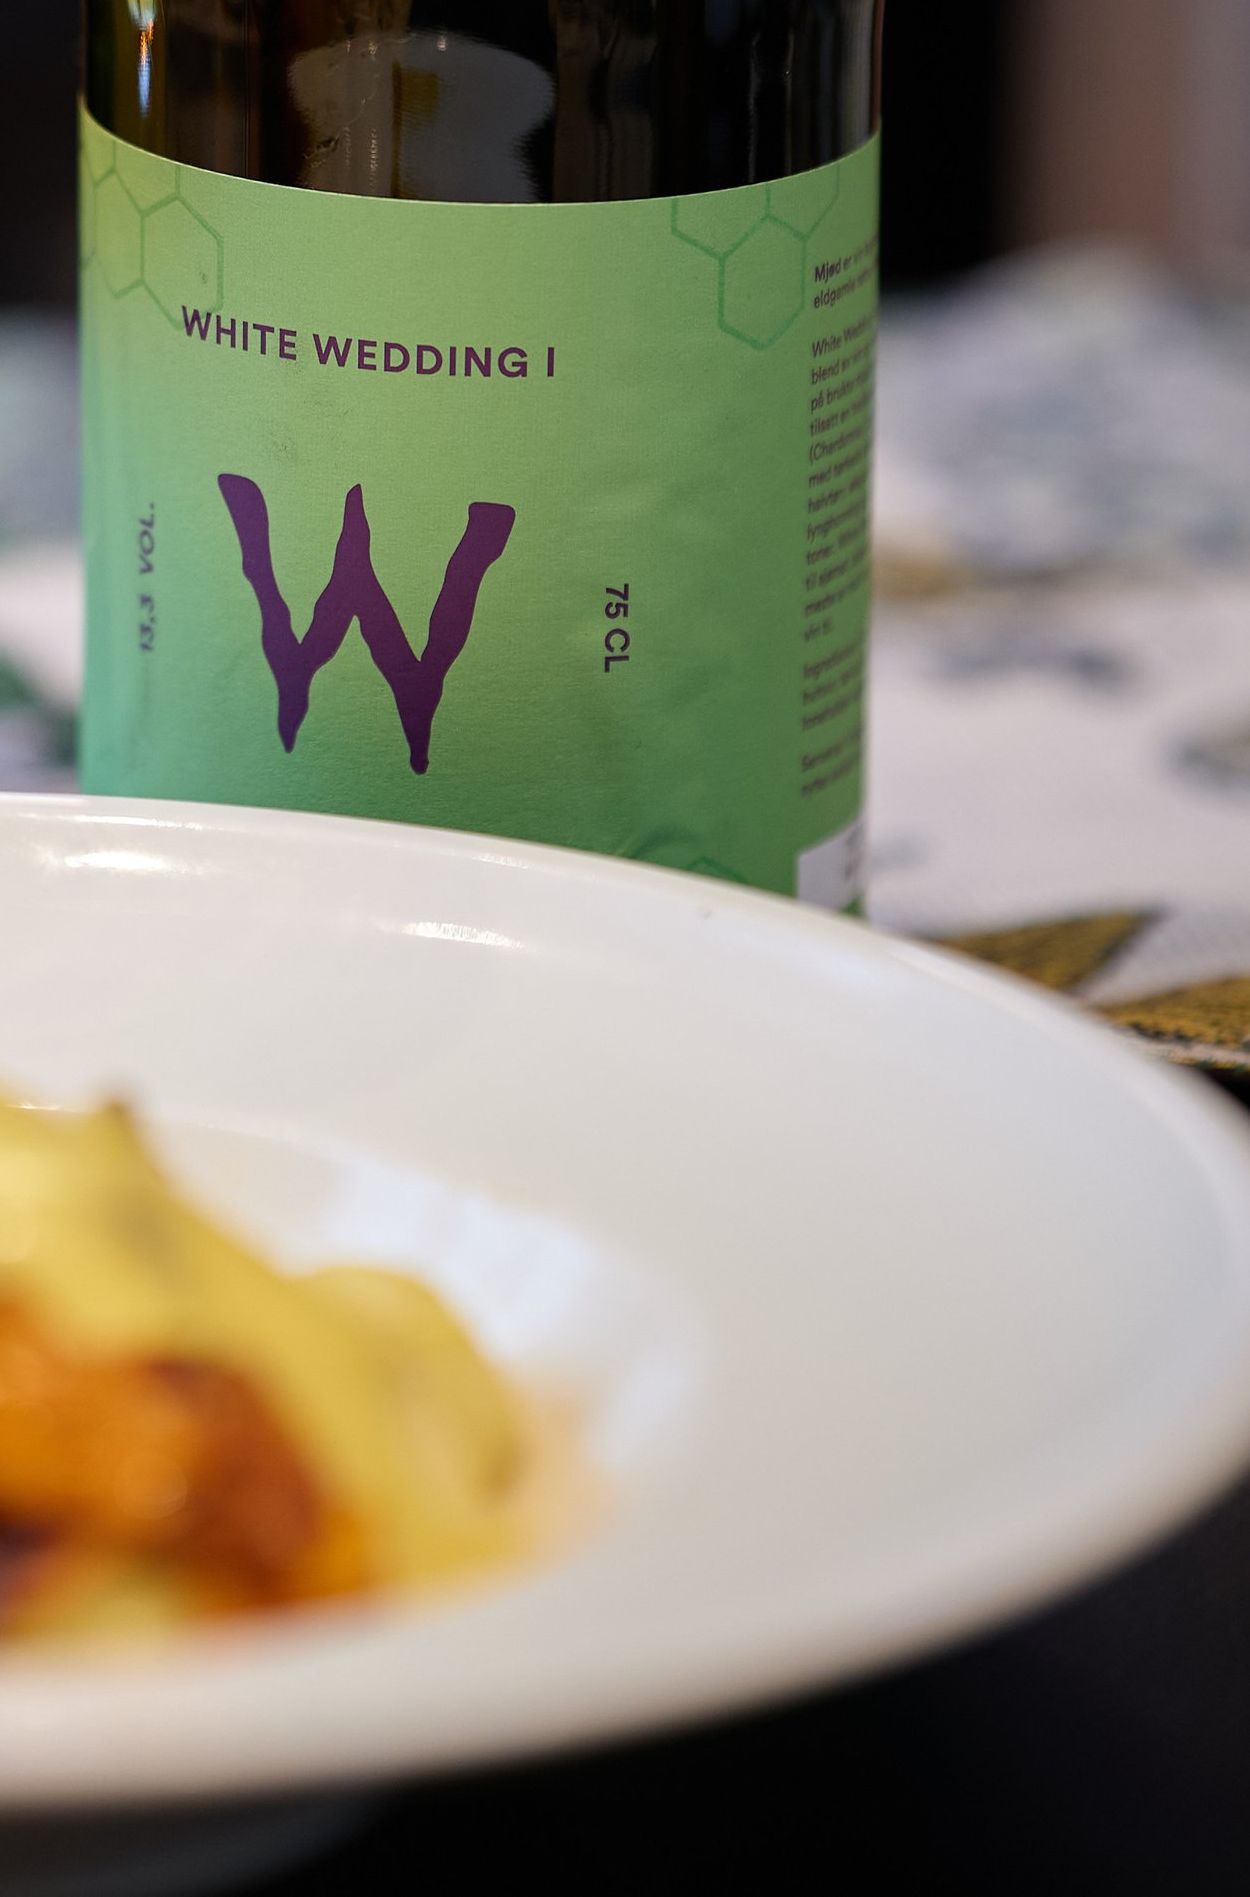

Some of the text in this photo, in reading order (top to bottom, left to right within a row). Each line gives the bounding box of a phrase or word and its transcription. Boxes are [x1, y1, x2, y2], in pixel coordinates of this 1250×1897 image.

[181, 305, 297, 360] WHITE
[313, 333, 528, 377] WEDDING
[812, 333, 841, 358] White
[139, 503, 155, 575] VOL.
[217, 473, 516, 774] W
[605, 583, 630, 673] 75 CL
